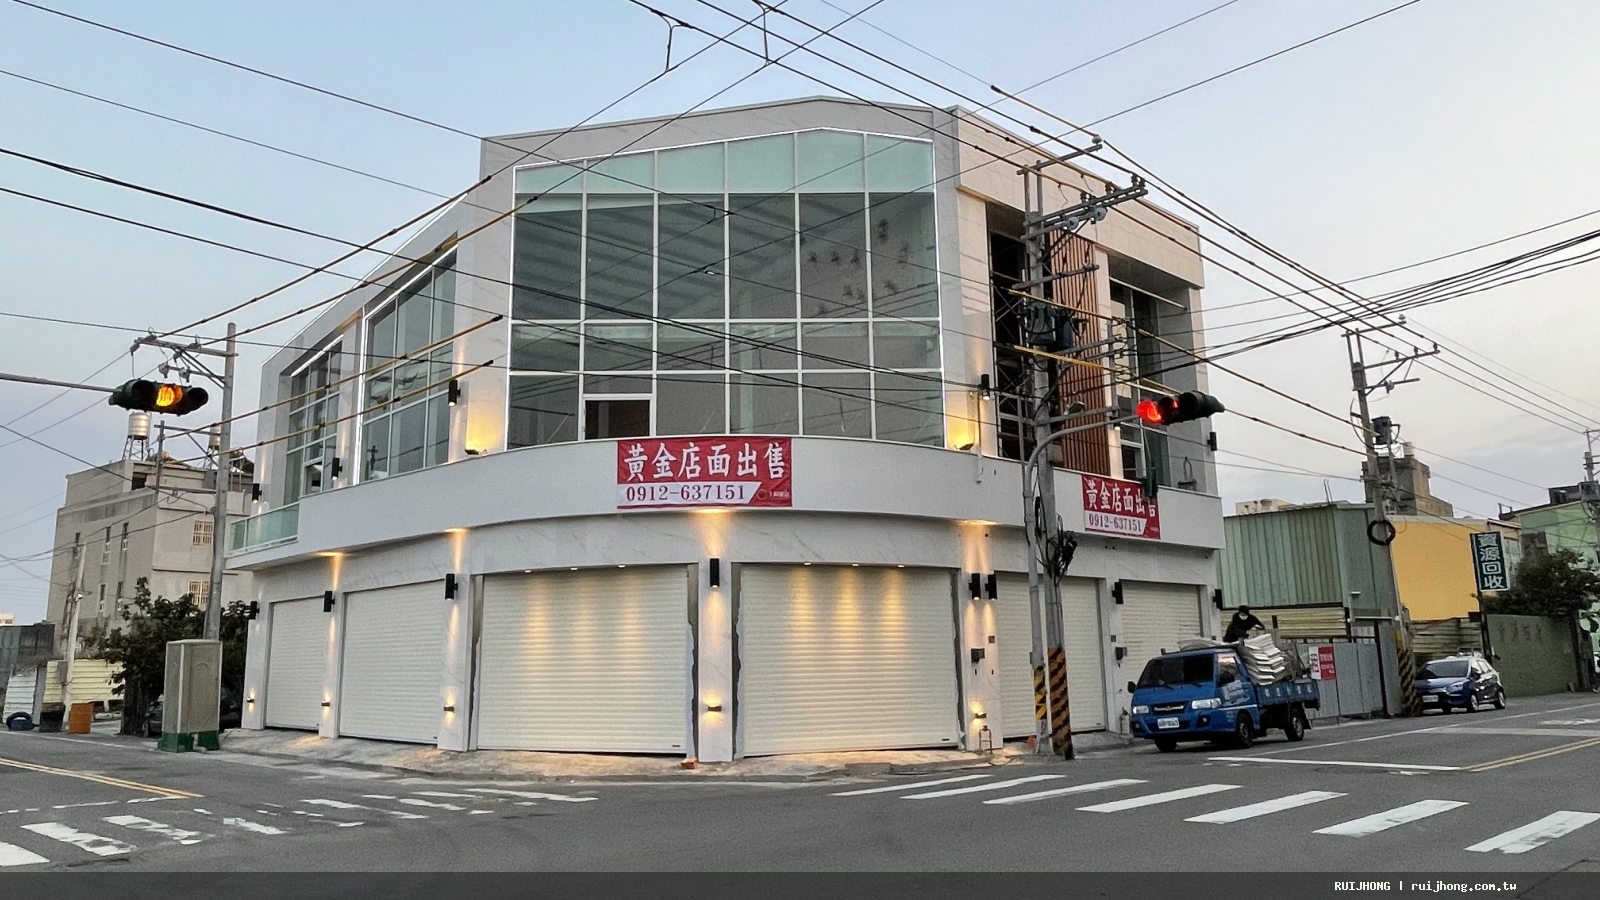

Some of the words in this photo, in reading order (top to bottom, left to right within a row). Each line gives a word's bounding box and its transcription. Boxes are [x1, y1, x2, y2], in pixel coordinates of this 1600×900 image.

[624, 442, 785, 482] 黃金店面出售
[626, 485, 745, 501] 0912-637151
[1088, 513, 1141, 532] 0912-637151
[1477, 534, 1505, 589] 資源回收
